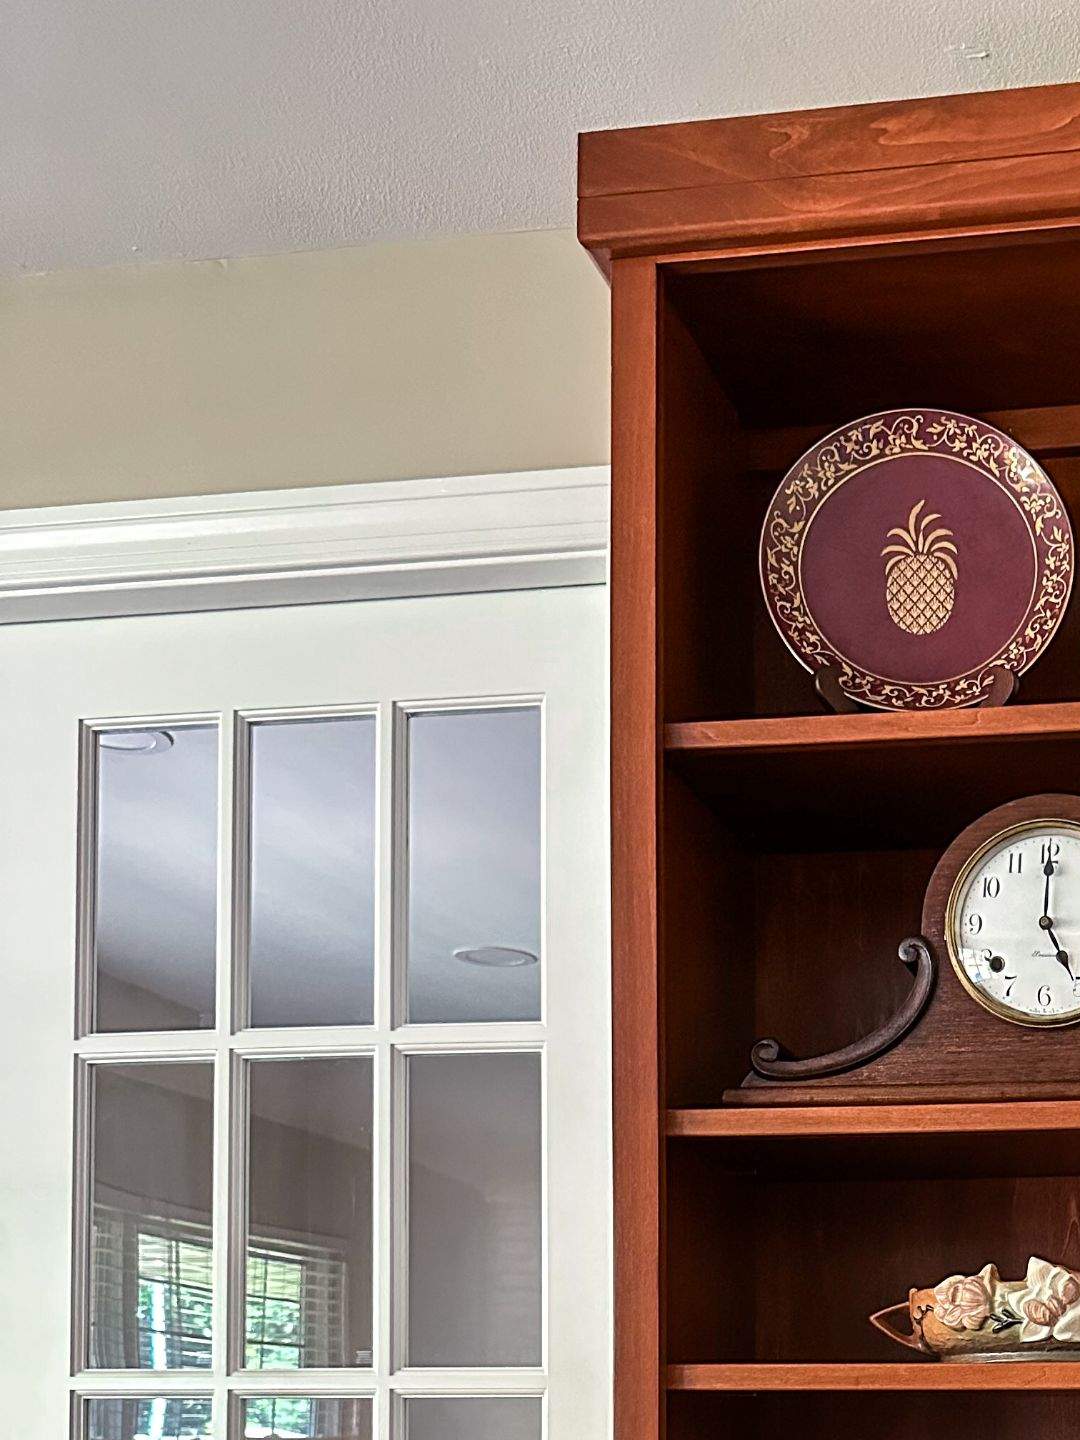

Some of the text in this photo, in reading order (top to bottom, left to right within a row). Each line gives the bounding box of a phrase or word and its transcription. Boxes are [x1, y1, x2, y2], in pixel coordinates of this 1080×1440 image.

[1008, 853, 1022, 874] 11
[982, 876, 1001, 898] 10
[968, 913, 983, 935] 9
[1004, 975, 1017, 997] 7
[1037, 985, 1052, 1007] 6
